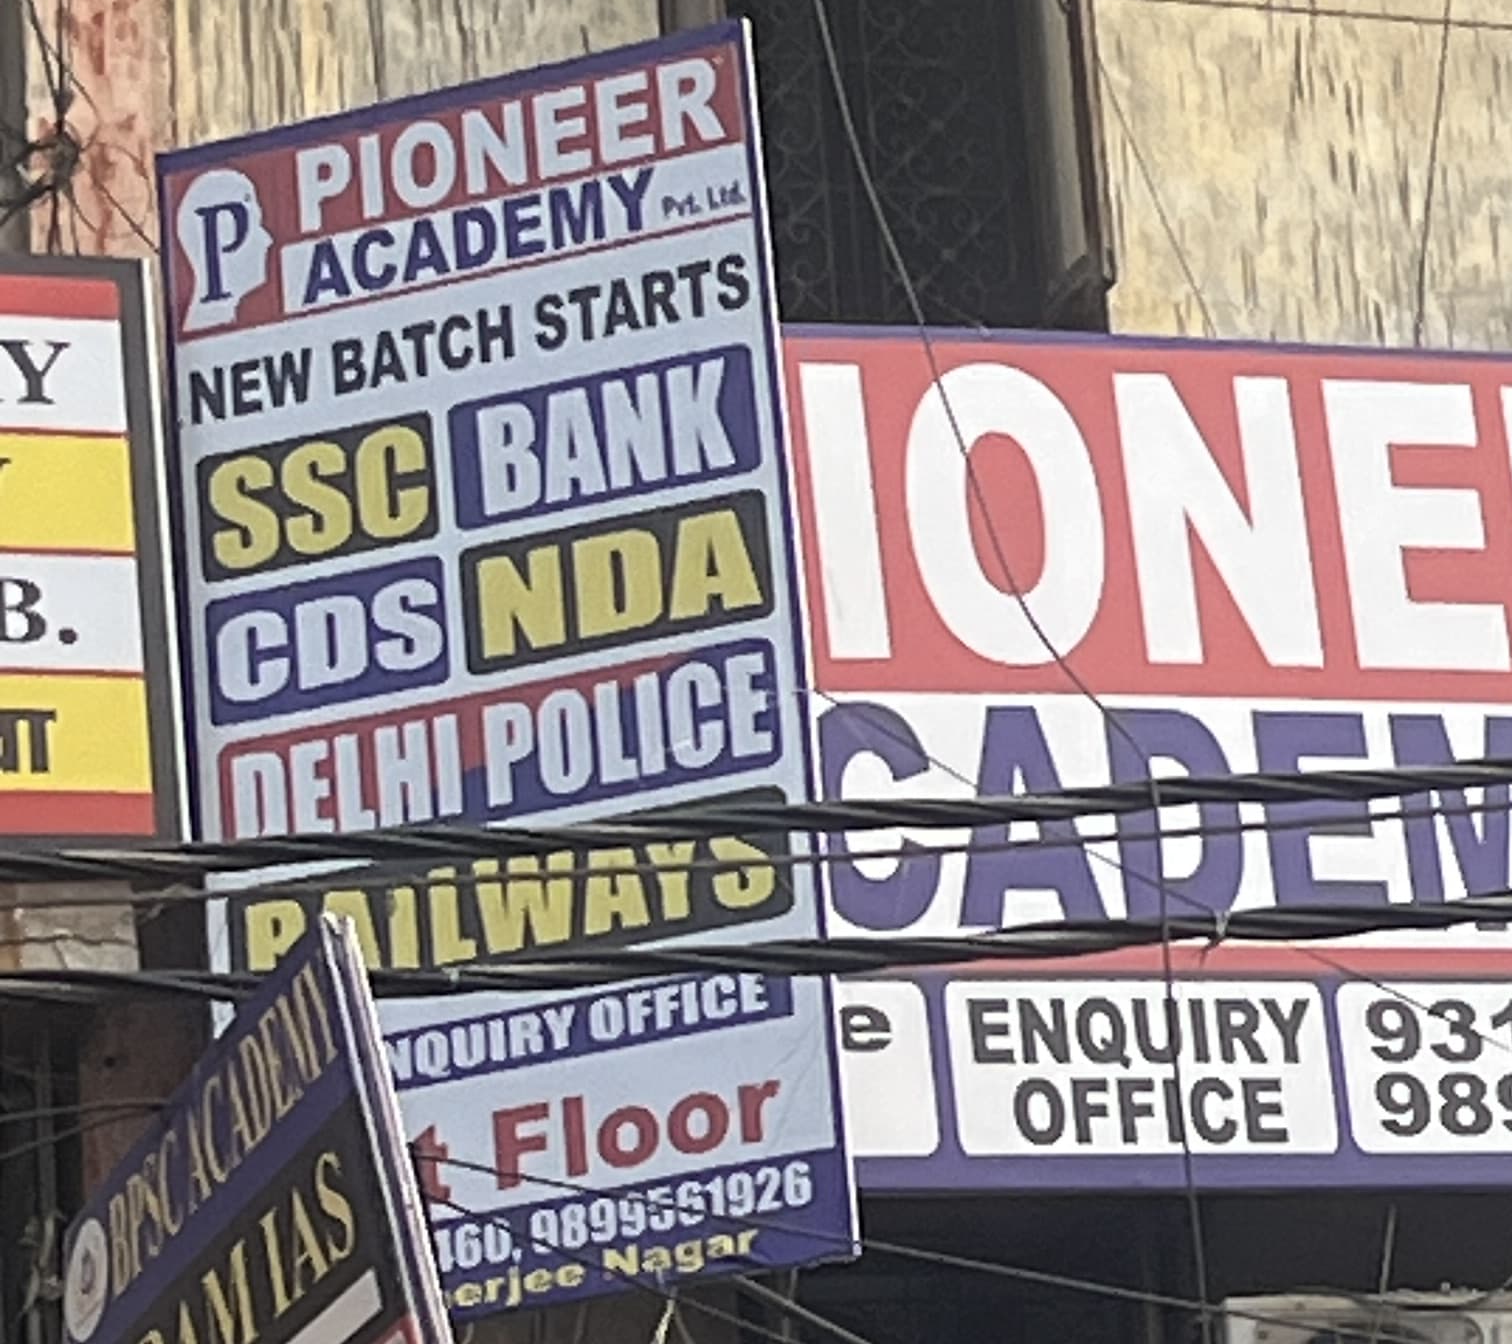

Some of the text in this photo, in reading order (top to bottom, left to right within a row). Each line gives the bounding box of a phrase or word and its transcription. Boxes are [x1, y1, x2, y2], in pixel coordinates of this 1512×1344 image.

[297, 58, 726, 233] PIONEER
[303, 168, 655, 305] ACADEMY
[189, 255, 751, 424] NEW BATCH STARTS
[208, 358, 736, 568] SSC BANK
[216, 511, 762, 703] CDS NDA
[229, 653, 773, 842] DELHI POLICE
[384, 974, 769, 1081] NQUIRY OFFICE
[966, 996, 1311, 1067] ENQUIRY
[492, 1080, 780, 1191] Floor
[1014, 1075, 1290, 1147] OFFICE
[260, 1151, 356, 1318] IAS
[447, 1229, 760, 1307] erjee Nagar
